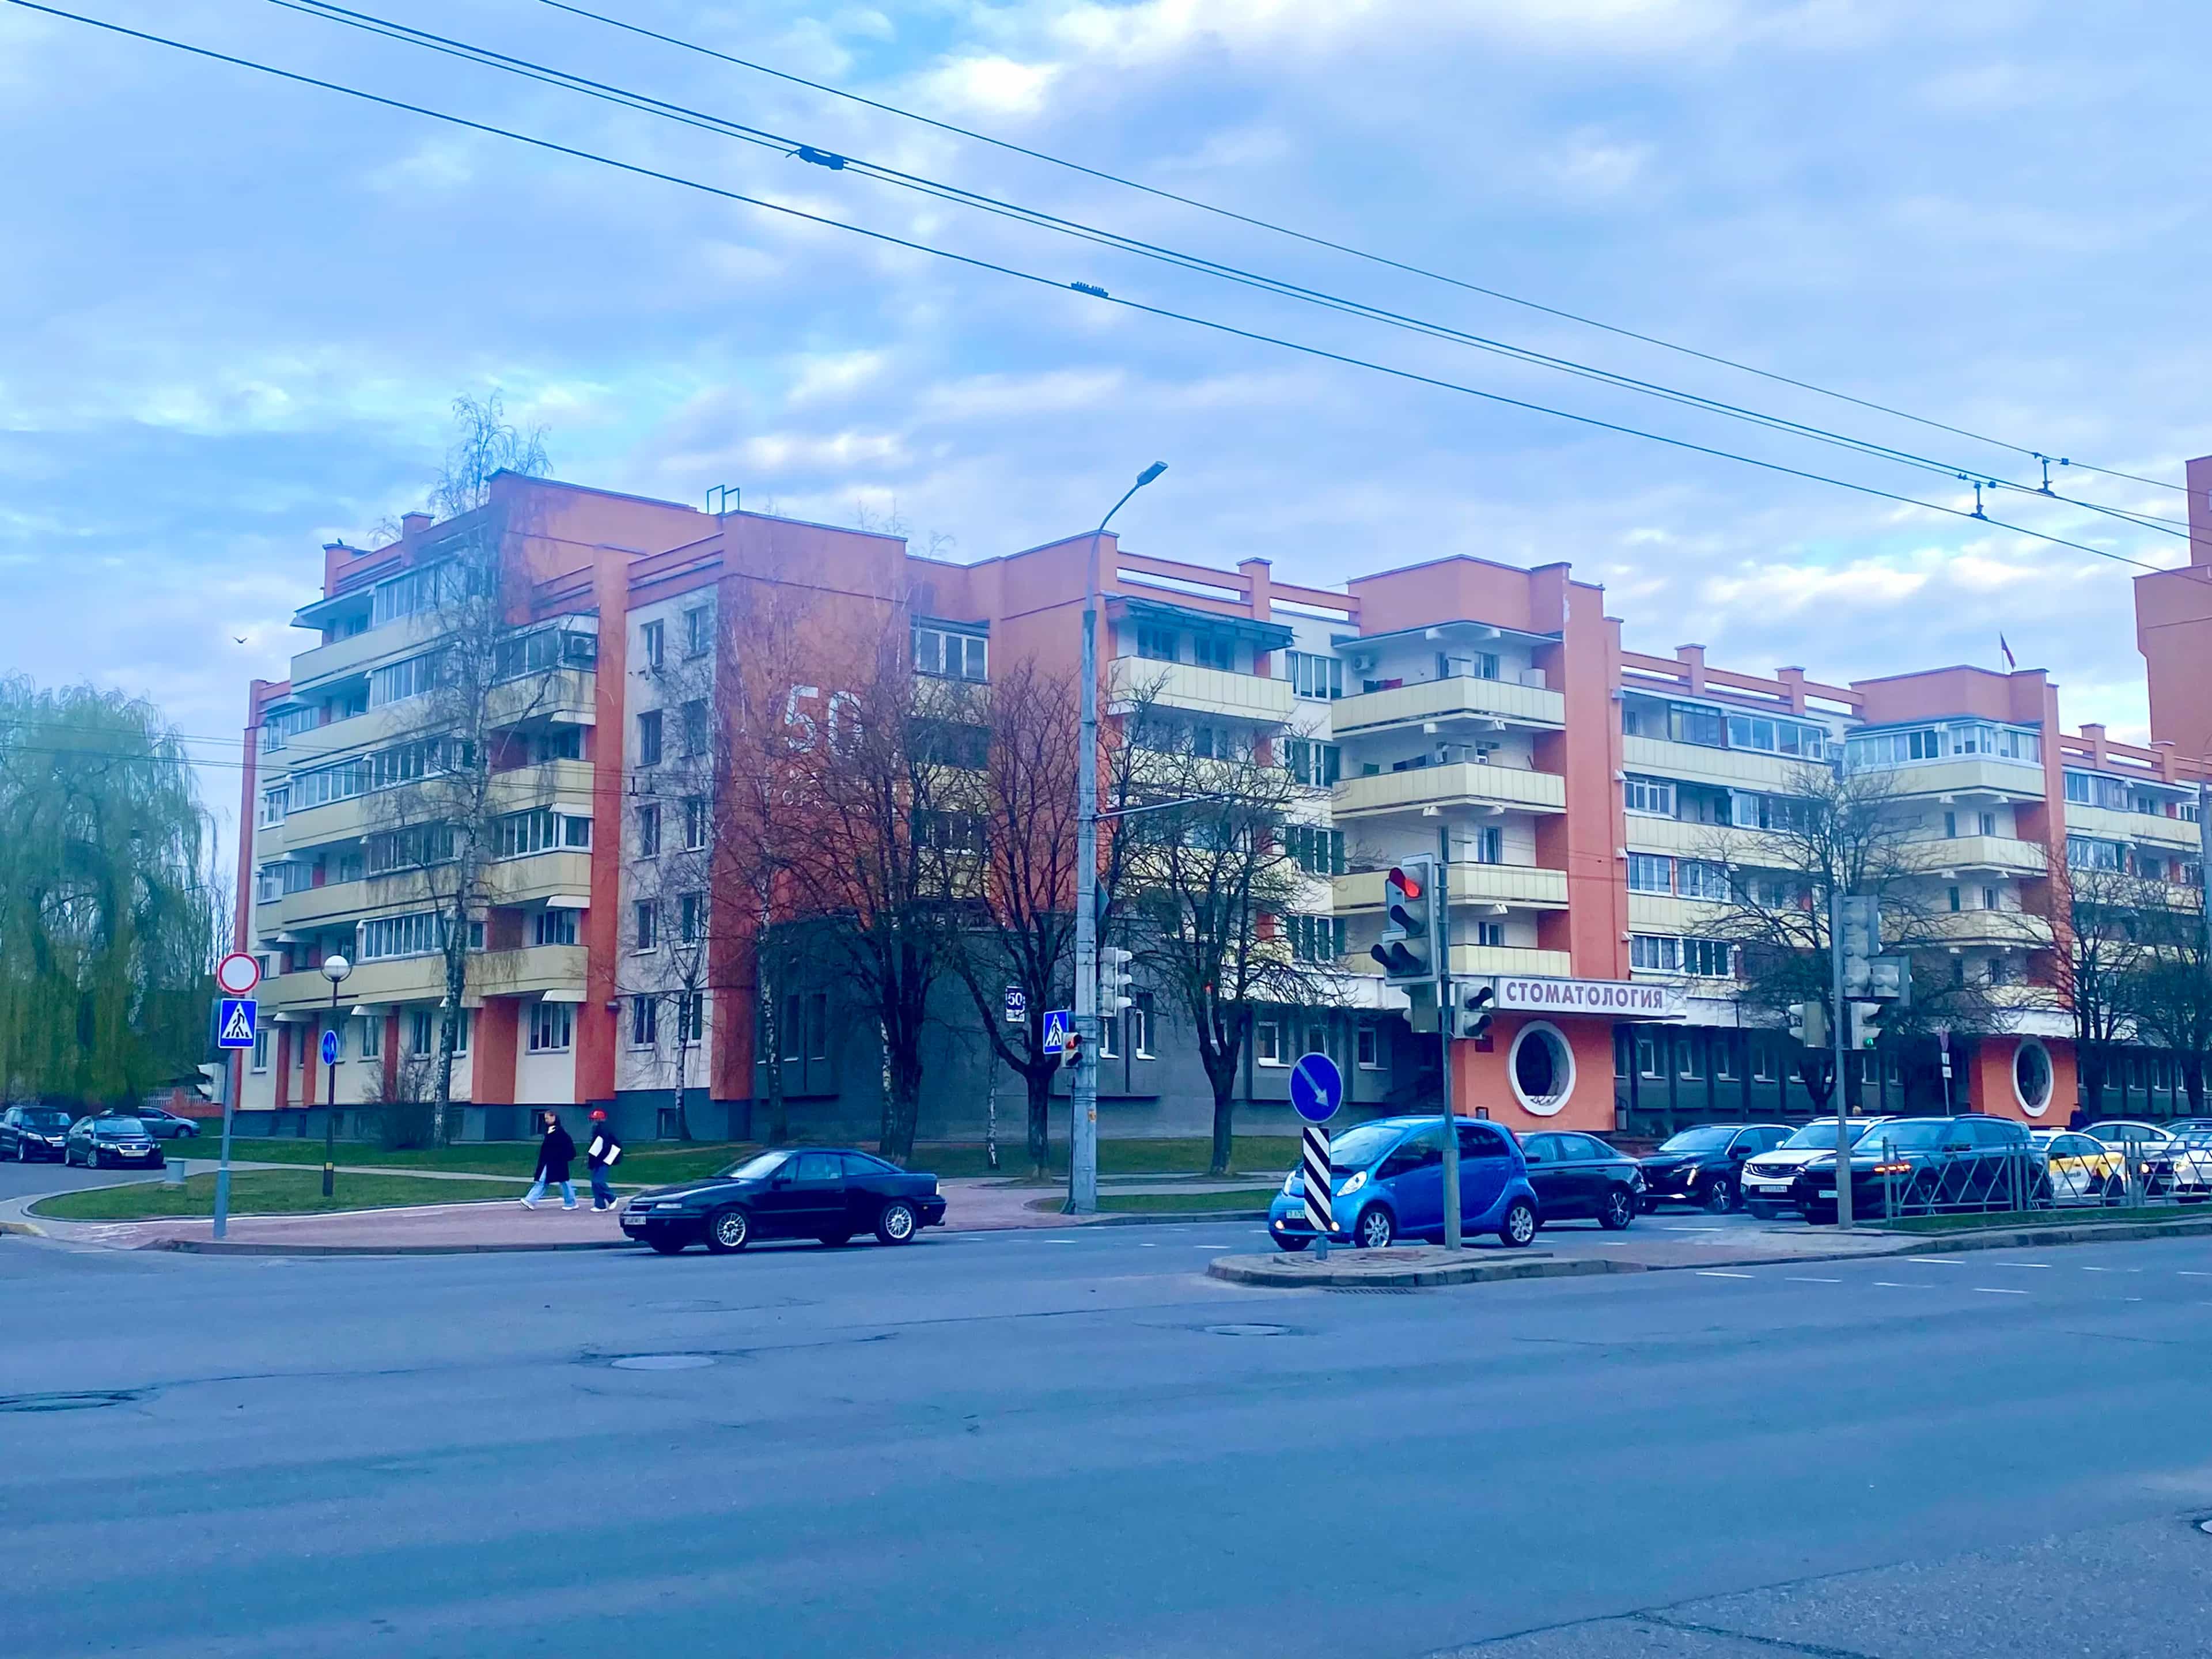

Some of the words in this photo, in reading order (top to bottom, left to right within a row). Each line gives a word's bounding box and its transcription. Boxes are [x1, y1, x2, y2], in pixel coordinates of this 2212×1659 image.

[784, 684, 863, 759] 50
[1008, 993, 1022, 1006] 50
[1506, 982, 1663, 1009] СТОМАТОЛОГИЯ
